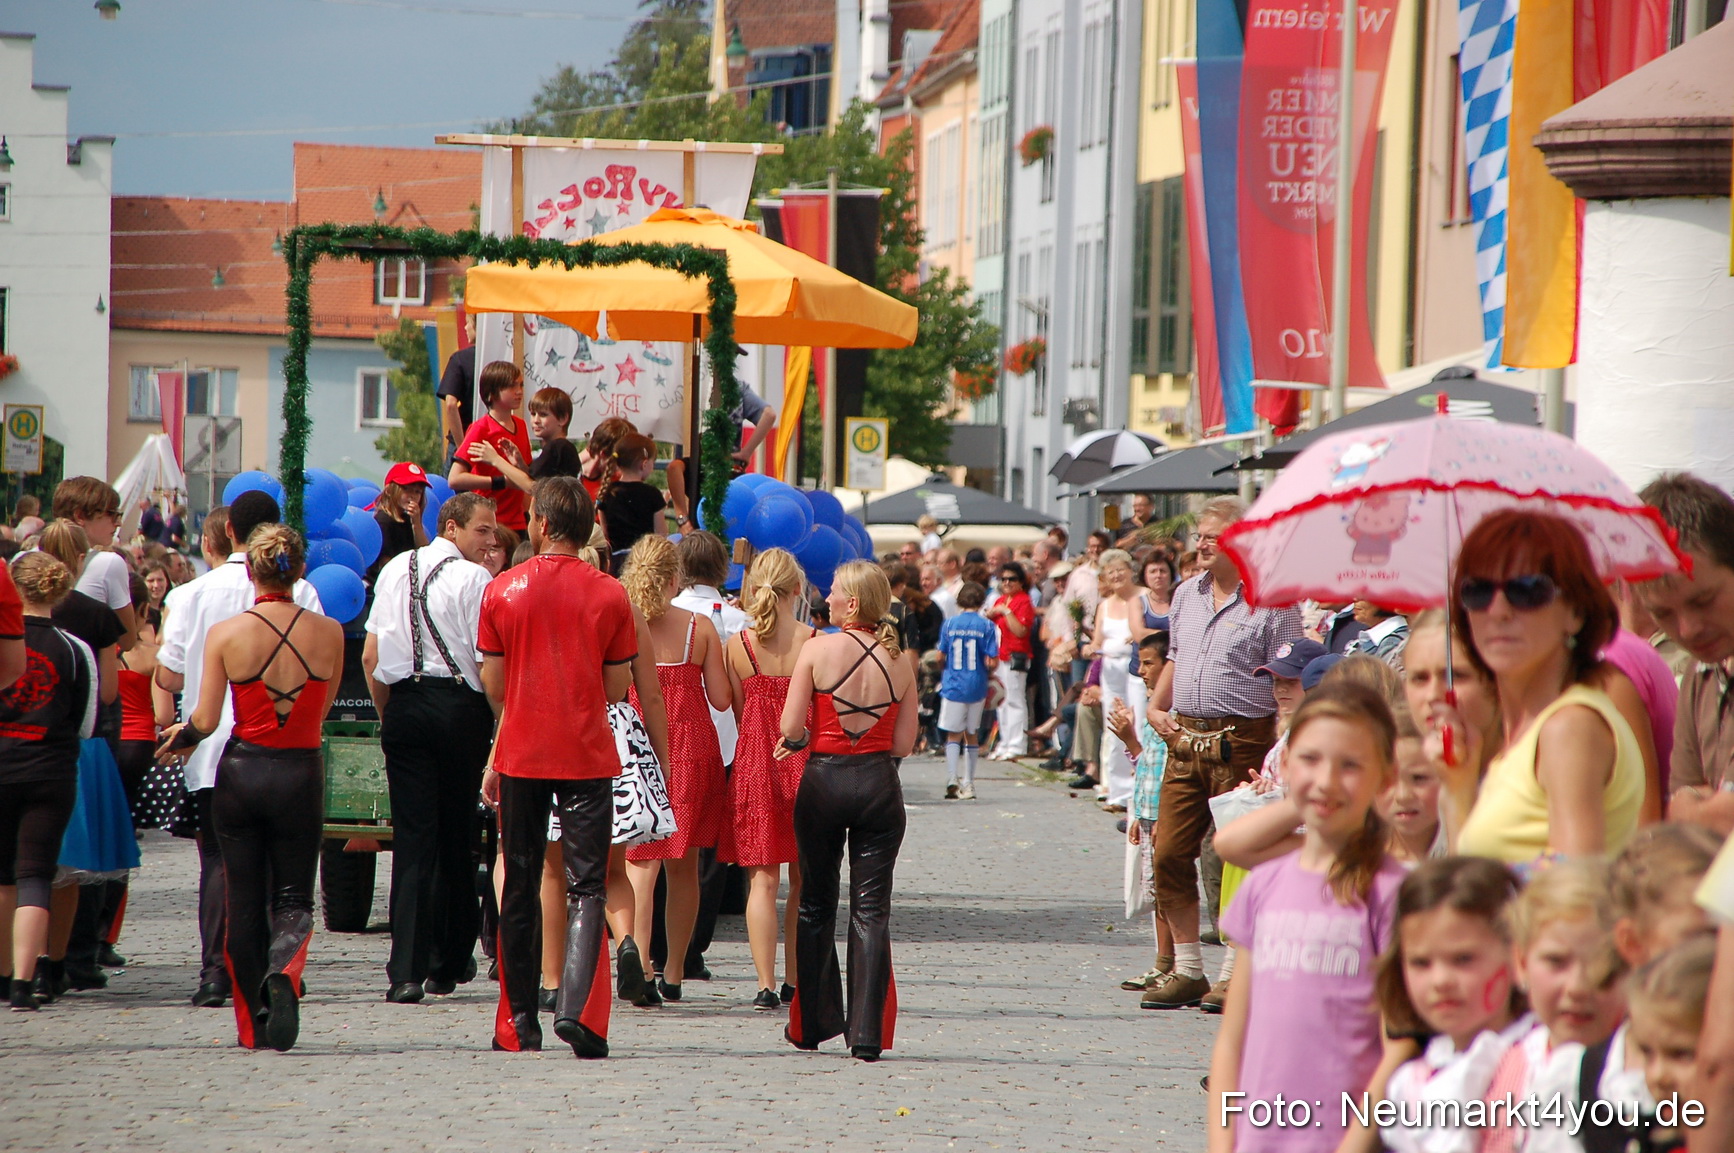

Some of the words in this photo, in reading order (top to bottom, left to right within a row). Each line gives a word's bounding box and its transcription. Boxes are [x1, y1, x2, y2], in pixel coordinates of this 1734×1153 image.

[17, 415, 31, 433] H
[861, 431, 874, 448] H
[952, 638, 977, 670] 11
[330, 698, 376, 707] NACOR
